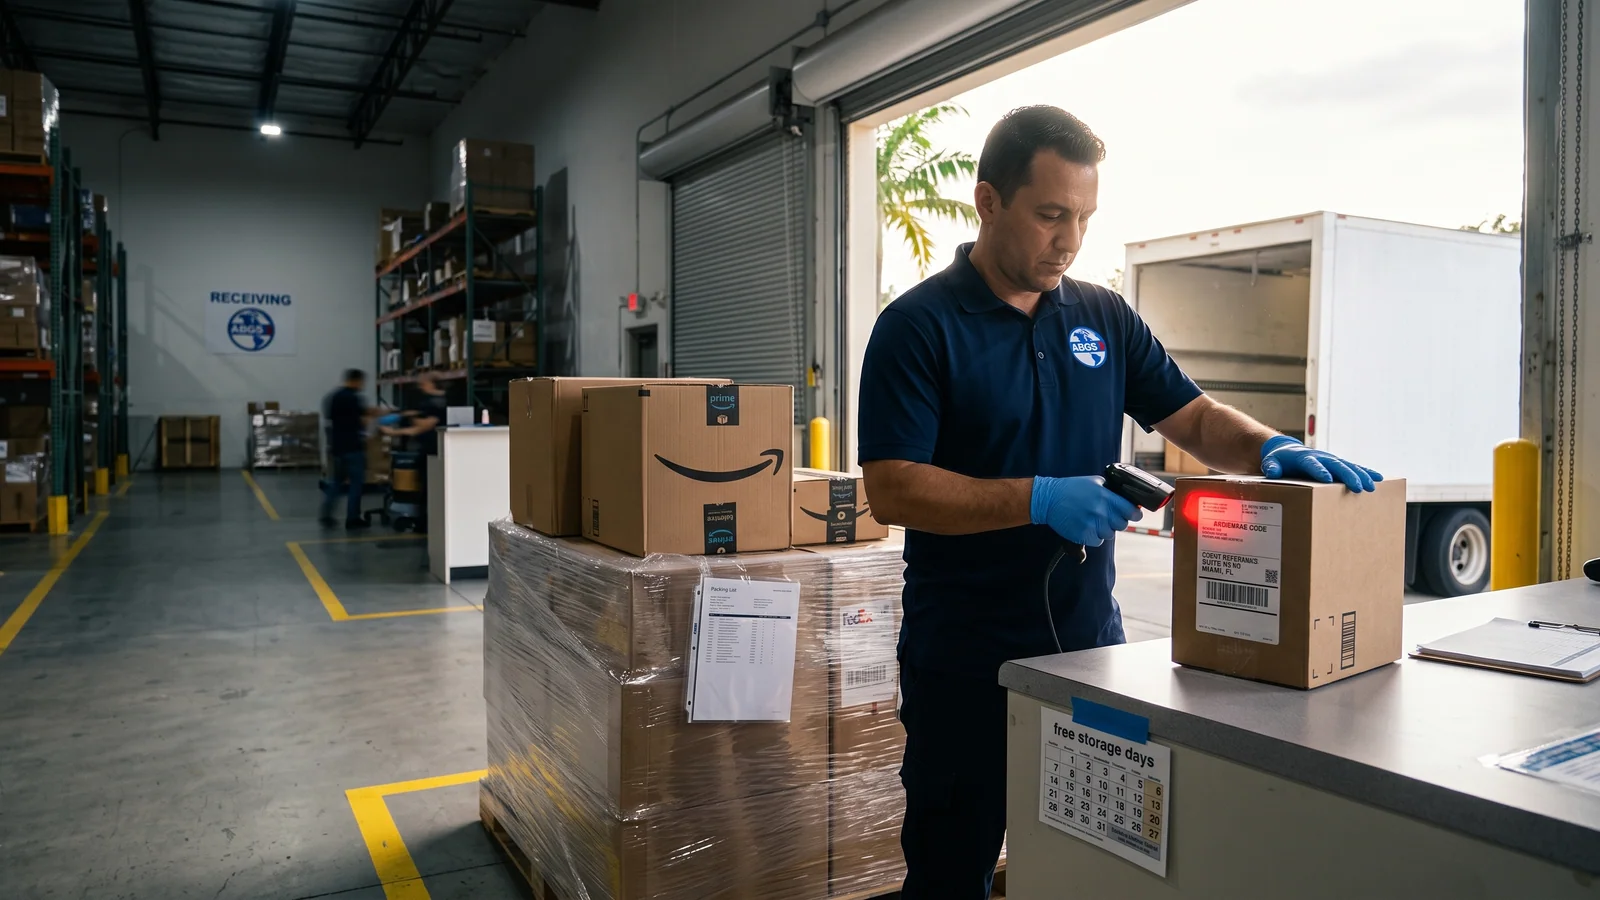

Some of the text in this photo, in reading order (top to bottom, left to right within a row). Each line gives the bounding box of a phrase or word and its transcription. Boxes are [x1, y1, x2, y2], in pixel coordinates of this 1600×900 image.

[210, 291, 292, 306] RECEIVING
[1072, 342, 1098, 352] ABGS
[710, 393, 735, 404] prime
[1249, 524, 1268, 533] CODE
[1201, 558, 1222, 567] SUITE
[1201, 565, 1234, 576] MIAMI, FL
[710, 586, 729, 594] Packing
[1053, 722, 1075, 740] free
[1077, 732, 1122, 757] storage
[1124, 747, 1155, 768] days
[1071, 756, 1161, 796] 1 2 3 4 5 6
[1053, 763, 1161, 811] 7 8 9 10 11 12 13
[1050, 776, 1160, 826] 14 15 16 17 18 19 20
[1048, 802, 1058, 812] 28
[1064, 808, 1074, 818] 29
[1080, 814, 1090, 825] 30
[1096, 821, 1106, 831] 31
[1049, 789, 1057, 798] 21
[1064, 795, 1074, 805] 22
[1080, 801, 1090, 811] 23
[1097, 807, 1106, 818] 24
[1114, 814, 1124, 825] 25
[1131, 821, 1142, 833] 26
[1148, 829, 1159, 840] 27
